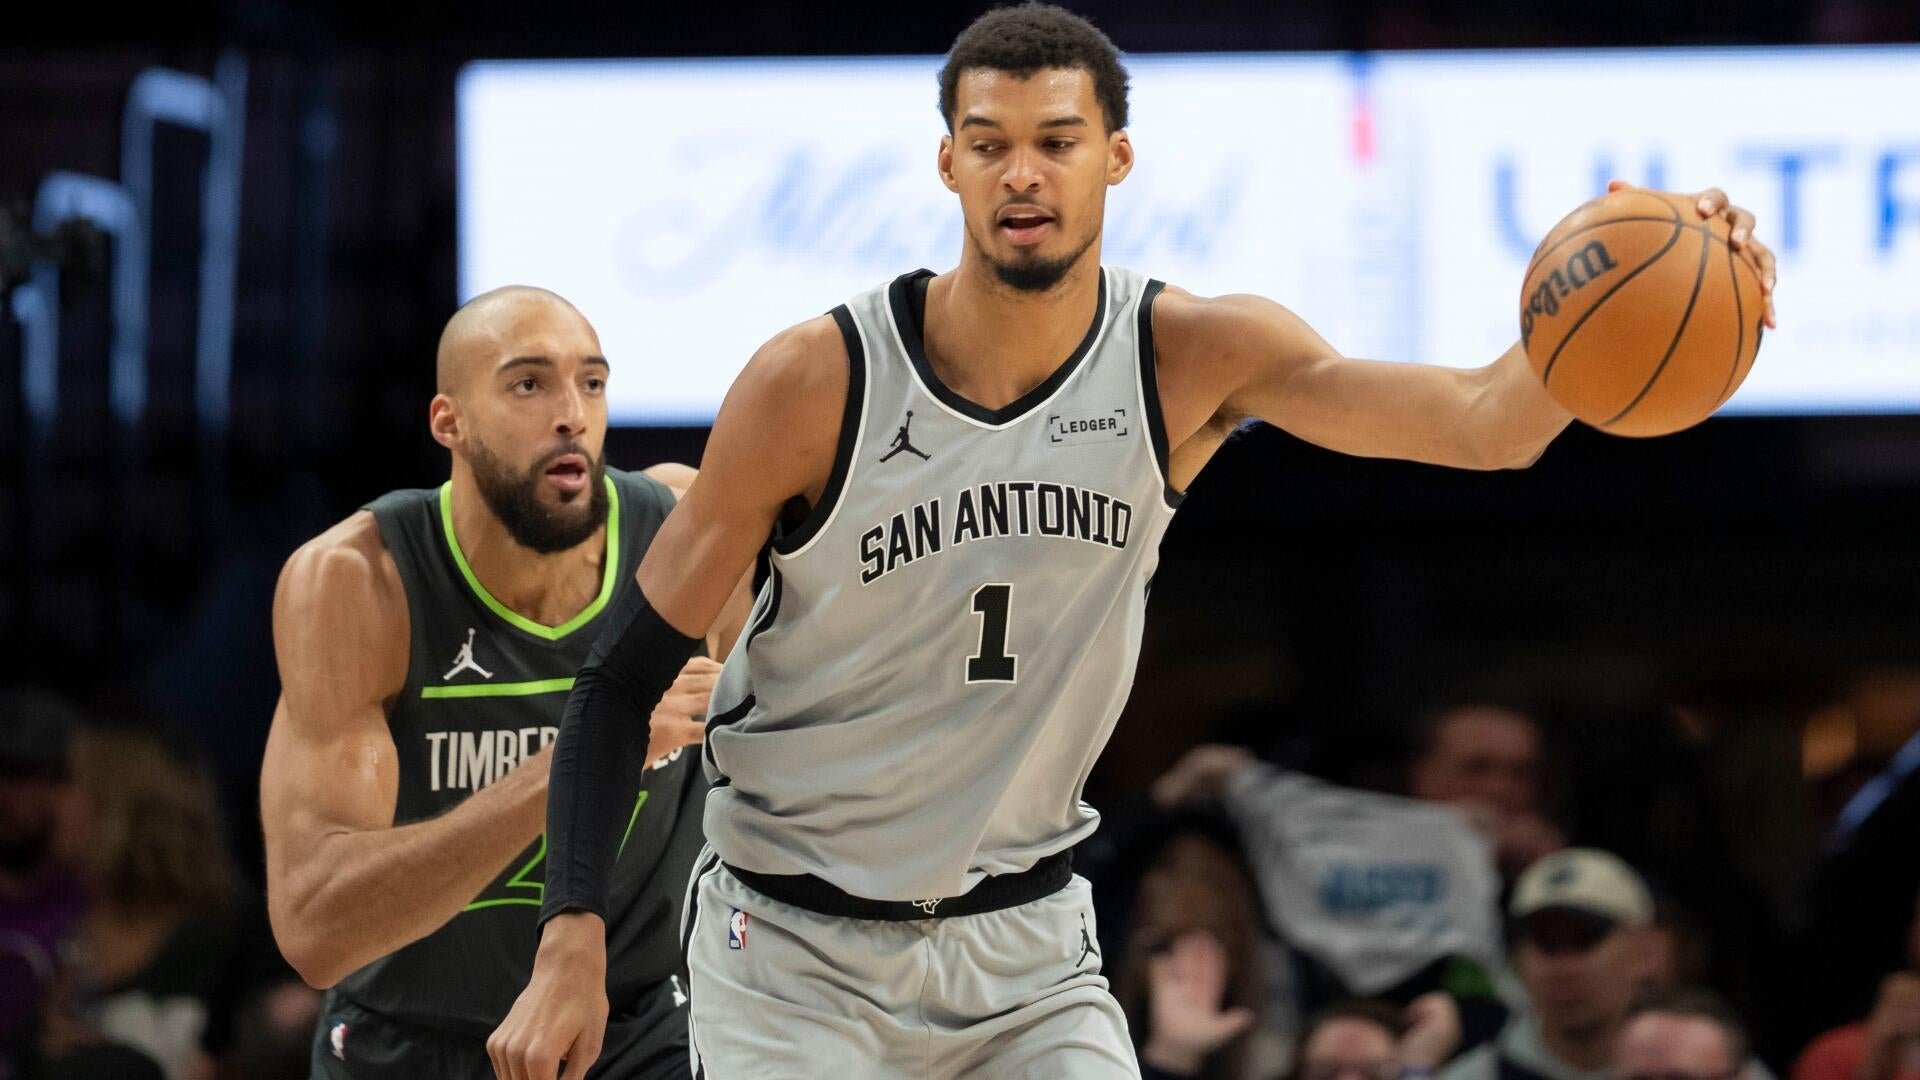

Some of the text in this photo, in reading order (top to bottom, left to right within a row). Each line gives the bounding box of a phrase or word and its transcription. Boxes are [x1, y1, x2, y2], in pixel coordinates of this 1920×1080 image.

[1520, 241, 1617, 350] Wilso
[1059, 417, 1117, 434] LEDGER
[860, 481, 1133, 585] SAN ANTONIO
[966, 583, 1018, 684] 1
